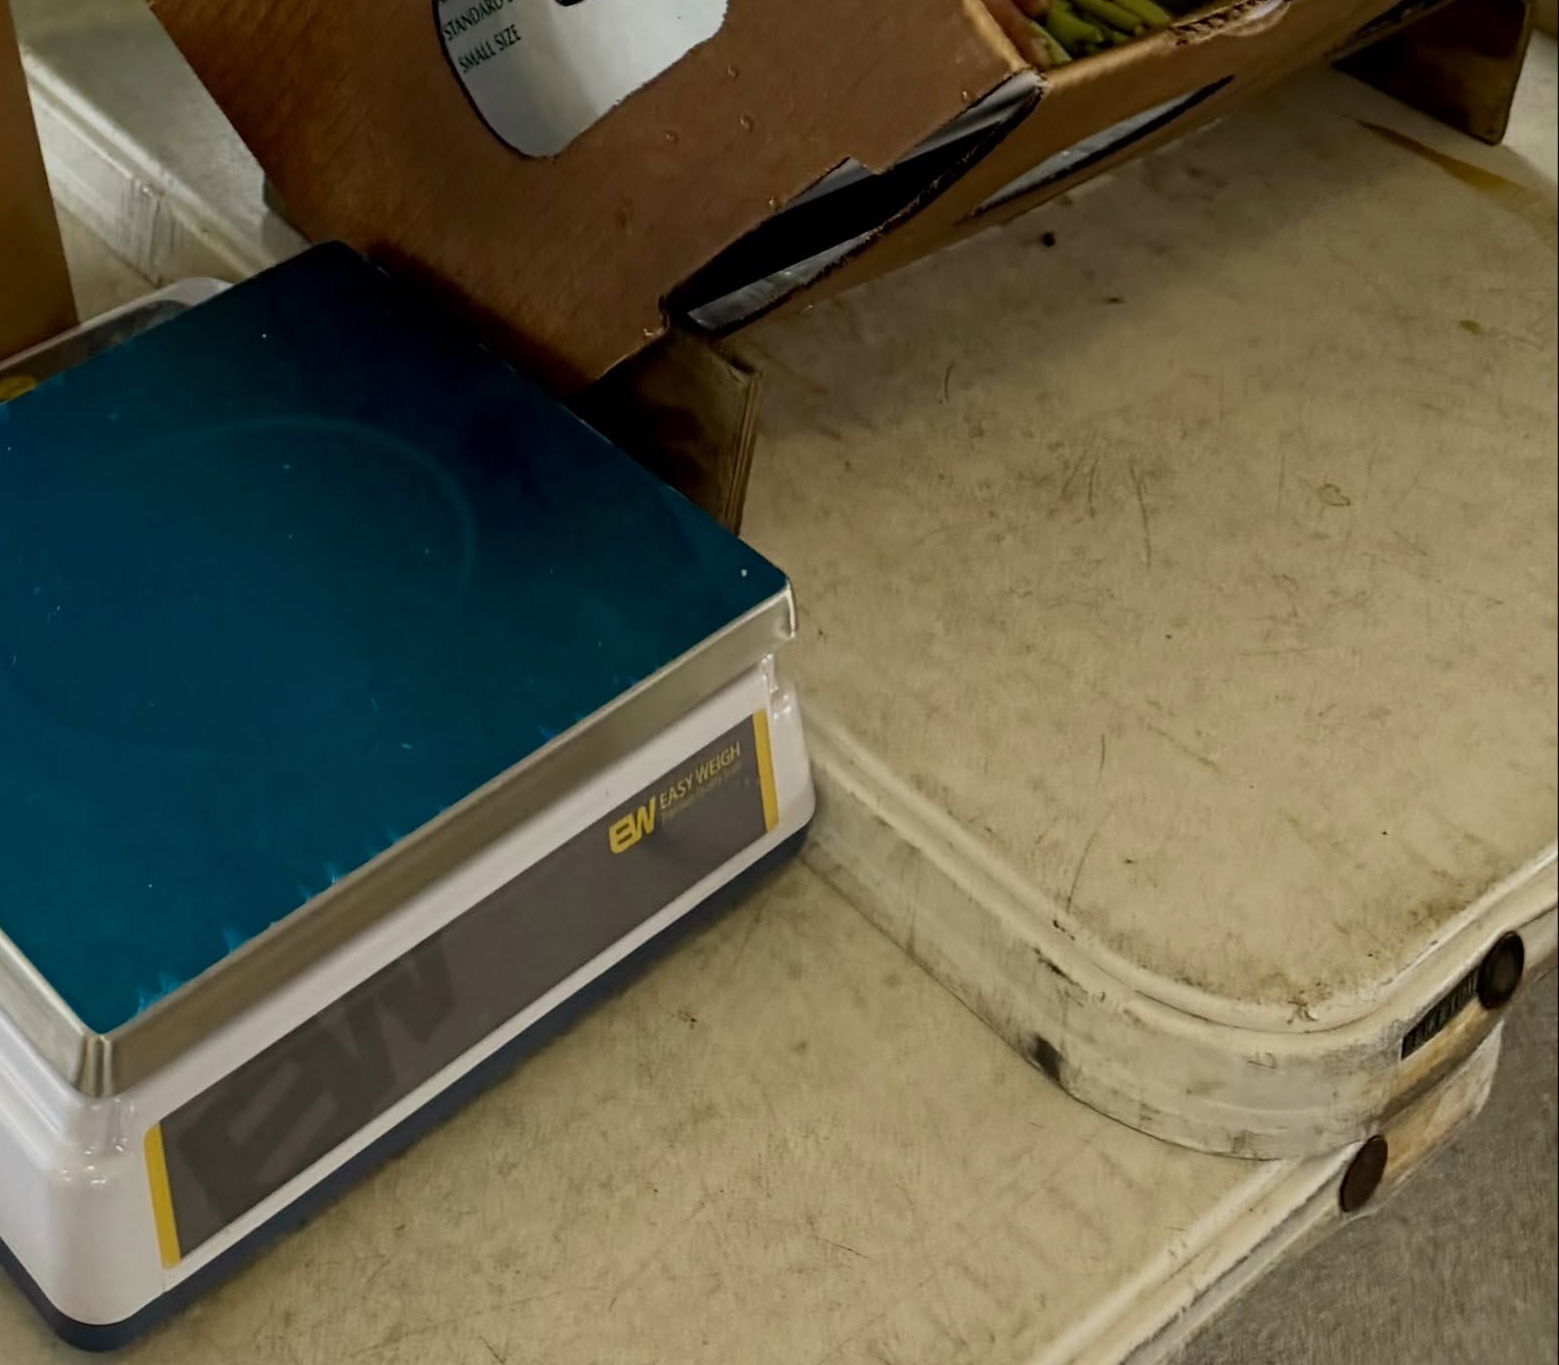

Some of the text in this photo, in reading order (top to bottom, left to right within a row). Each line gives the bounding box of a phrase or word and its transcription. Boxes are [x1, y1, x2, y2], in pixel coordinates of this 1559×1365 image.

[457, 23, 523, 74] SMALL SIZE
[658, 771, 695, 811] EASY
[694, 740, 742, 785] WEIGH
